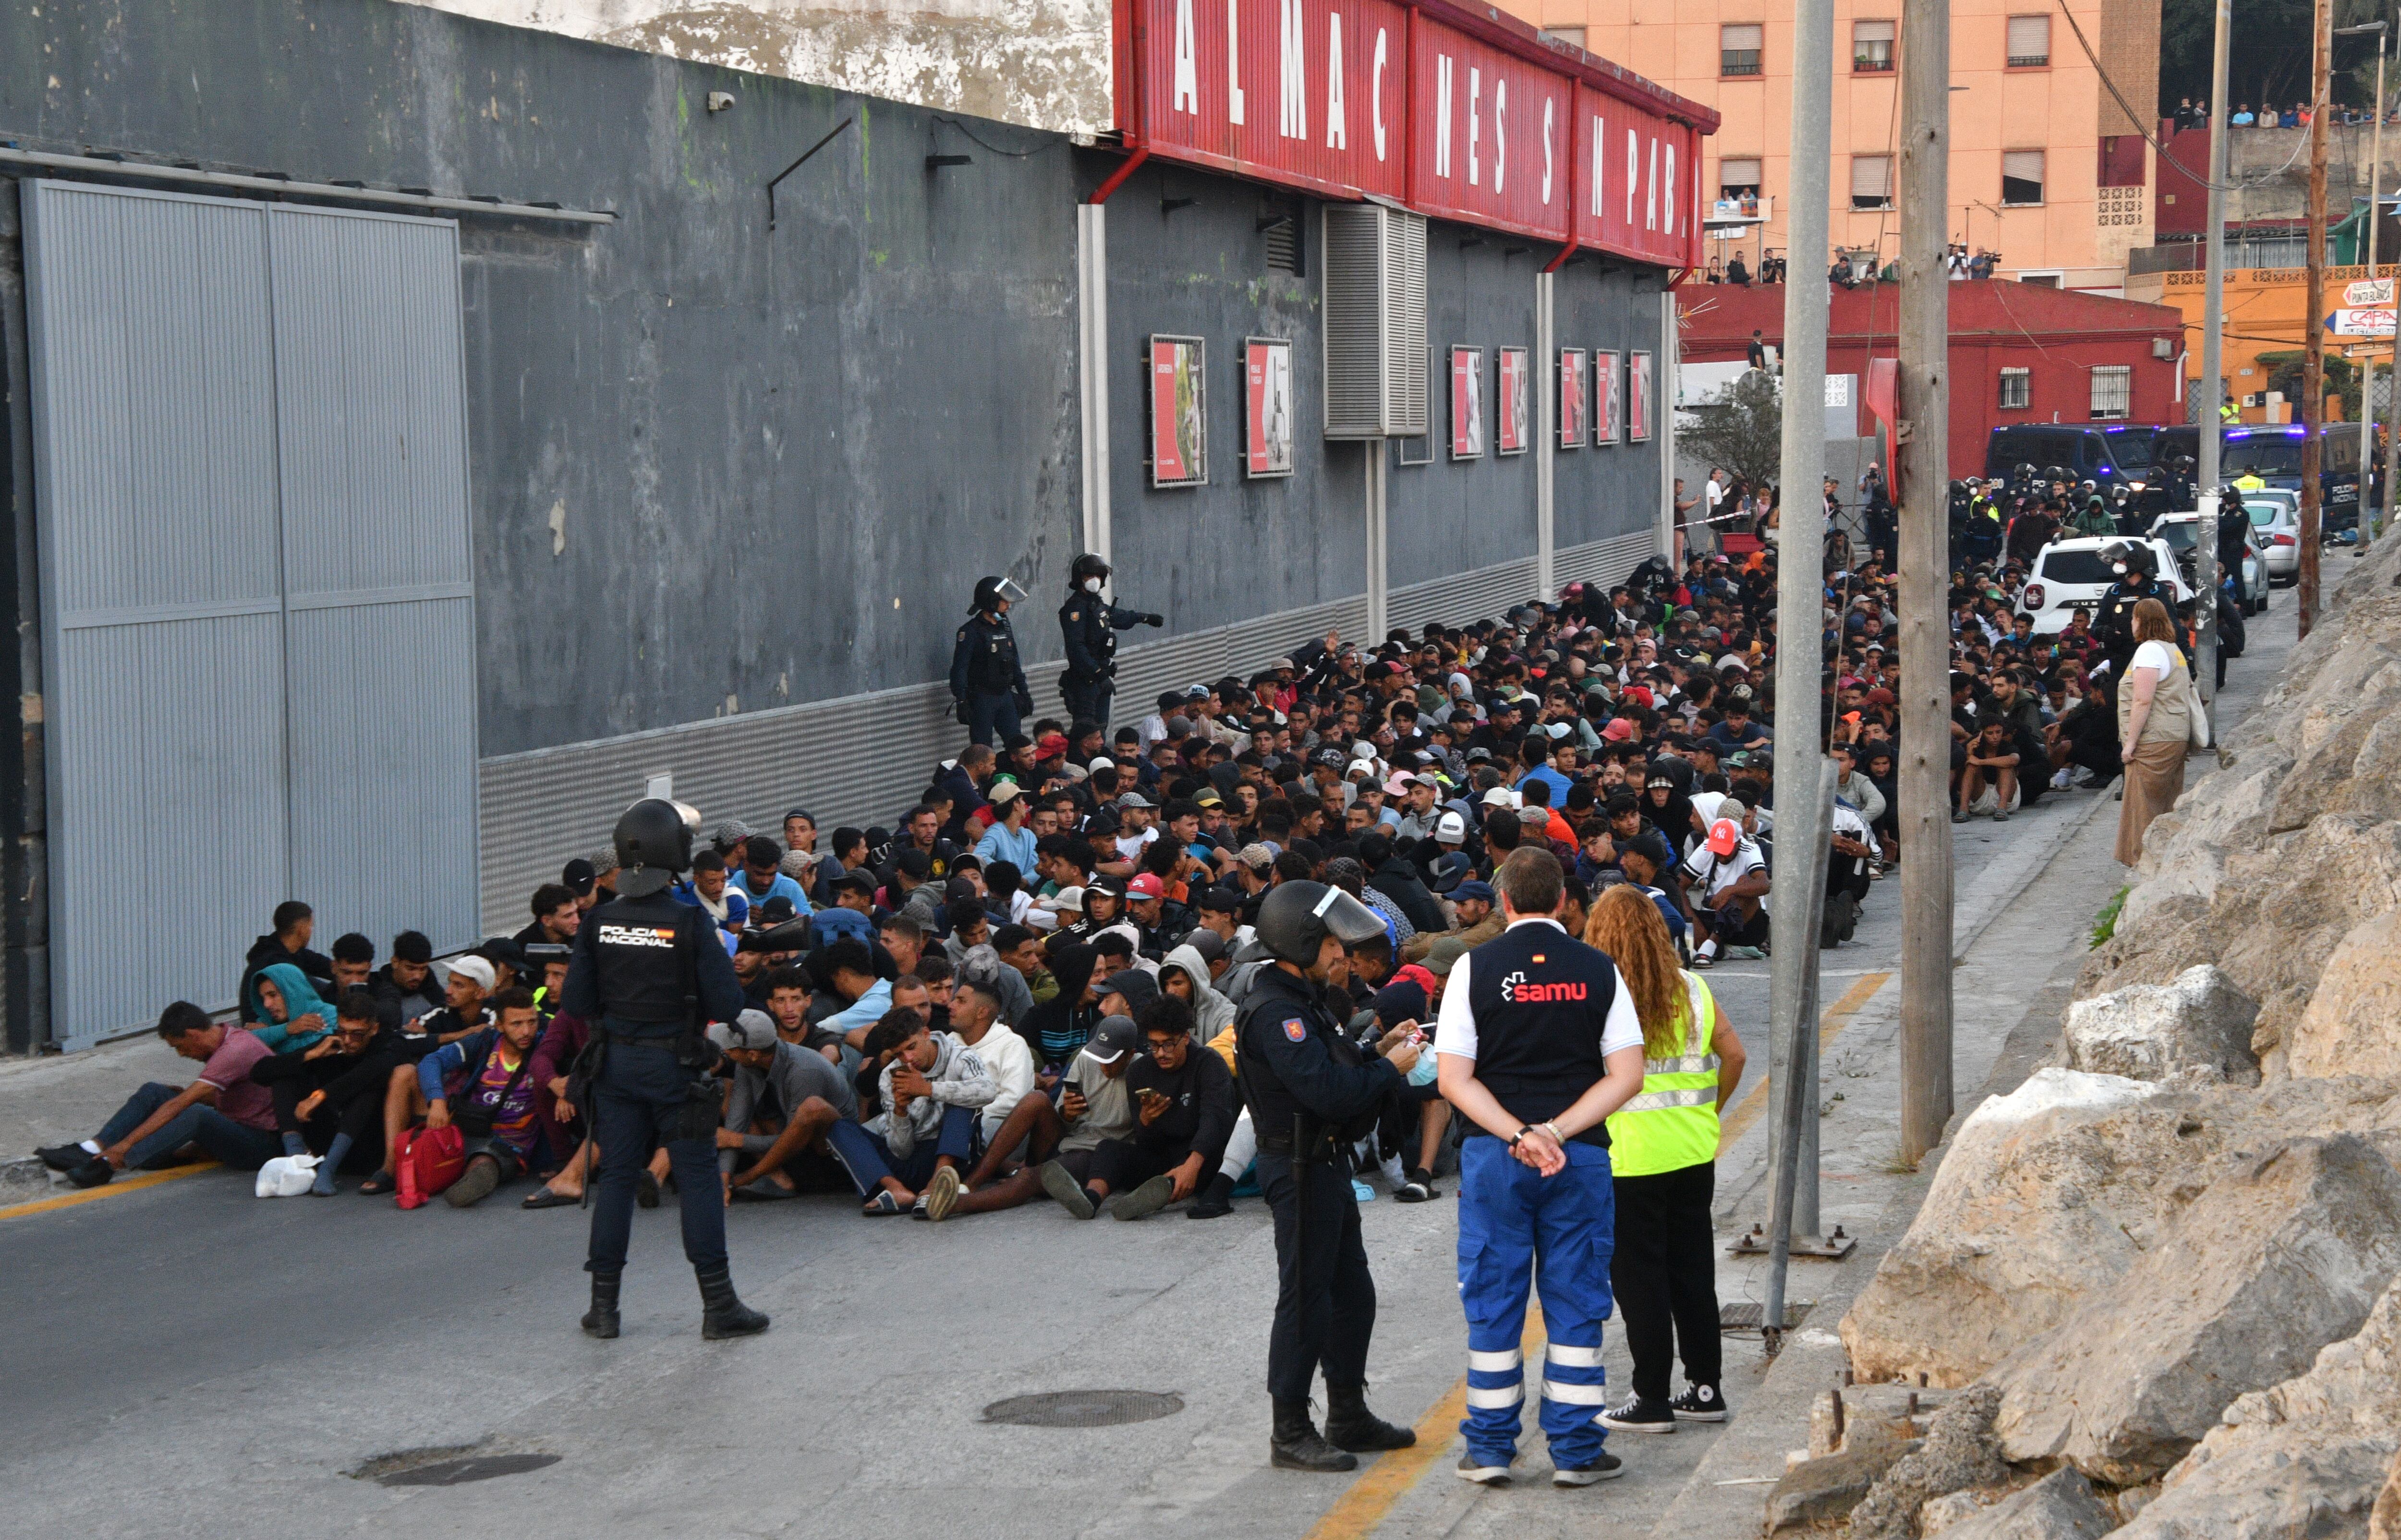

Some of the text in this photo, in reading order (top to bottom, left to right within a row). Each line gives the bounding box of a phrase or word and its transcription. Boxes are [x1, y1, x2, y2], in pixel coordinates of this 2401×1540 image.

[1174, 0, 1506, 194] ALMACNES
[1542, 96, 1604, 217] SN
[2350, 311, 2398, 324] CAPA
[599, 926, 658, 938] POLICIA
[599, 935, 674, 948] NACIONAL
[1514, 982, 1587, 1002] samu
